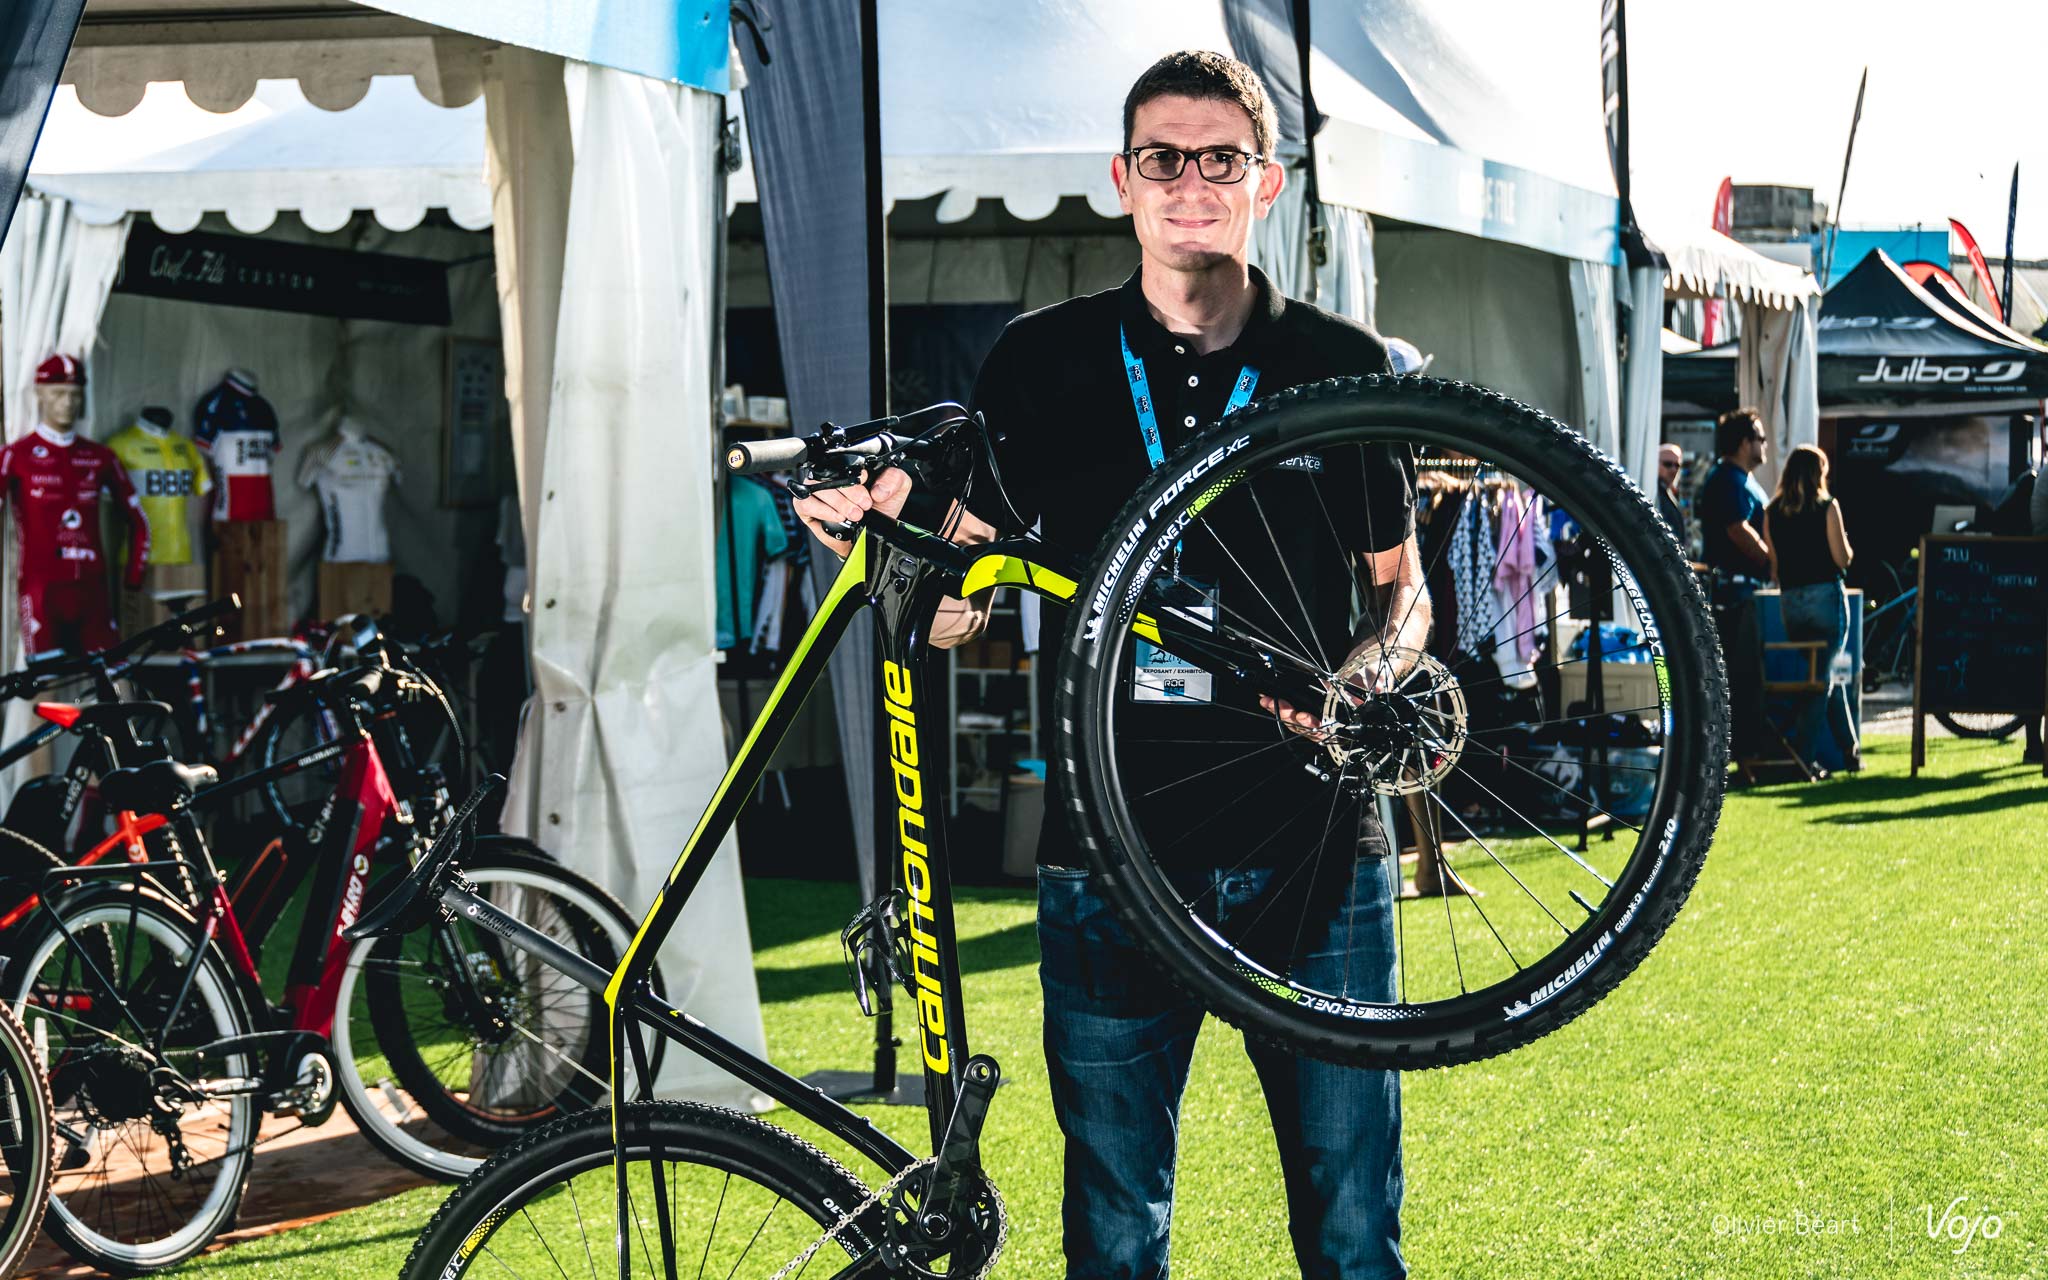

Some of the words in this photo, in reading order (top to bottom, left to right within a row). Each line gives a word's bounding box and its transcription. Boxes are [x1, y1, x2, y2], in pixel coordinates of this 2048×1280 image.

[1818, 315, 1879, 330] lbo
[1858, 357, 1970, 382] Julbo
[730, 454, 742, 464] ESI
[147, 470, 193, 496] BBB
[1092, 517, 1147, 615] MICHELIN
[1148, 446, 1225, 520] FORCE
[1226, 434, 1250, 456] XC
[883, 659, 949, 1076] cannondale
[1530, 930, 1611, 1004] MICHELIN
[1658, 818, 1677, 856] 2.10
